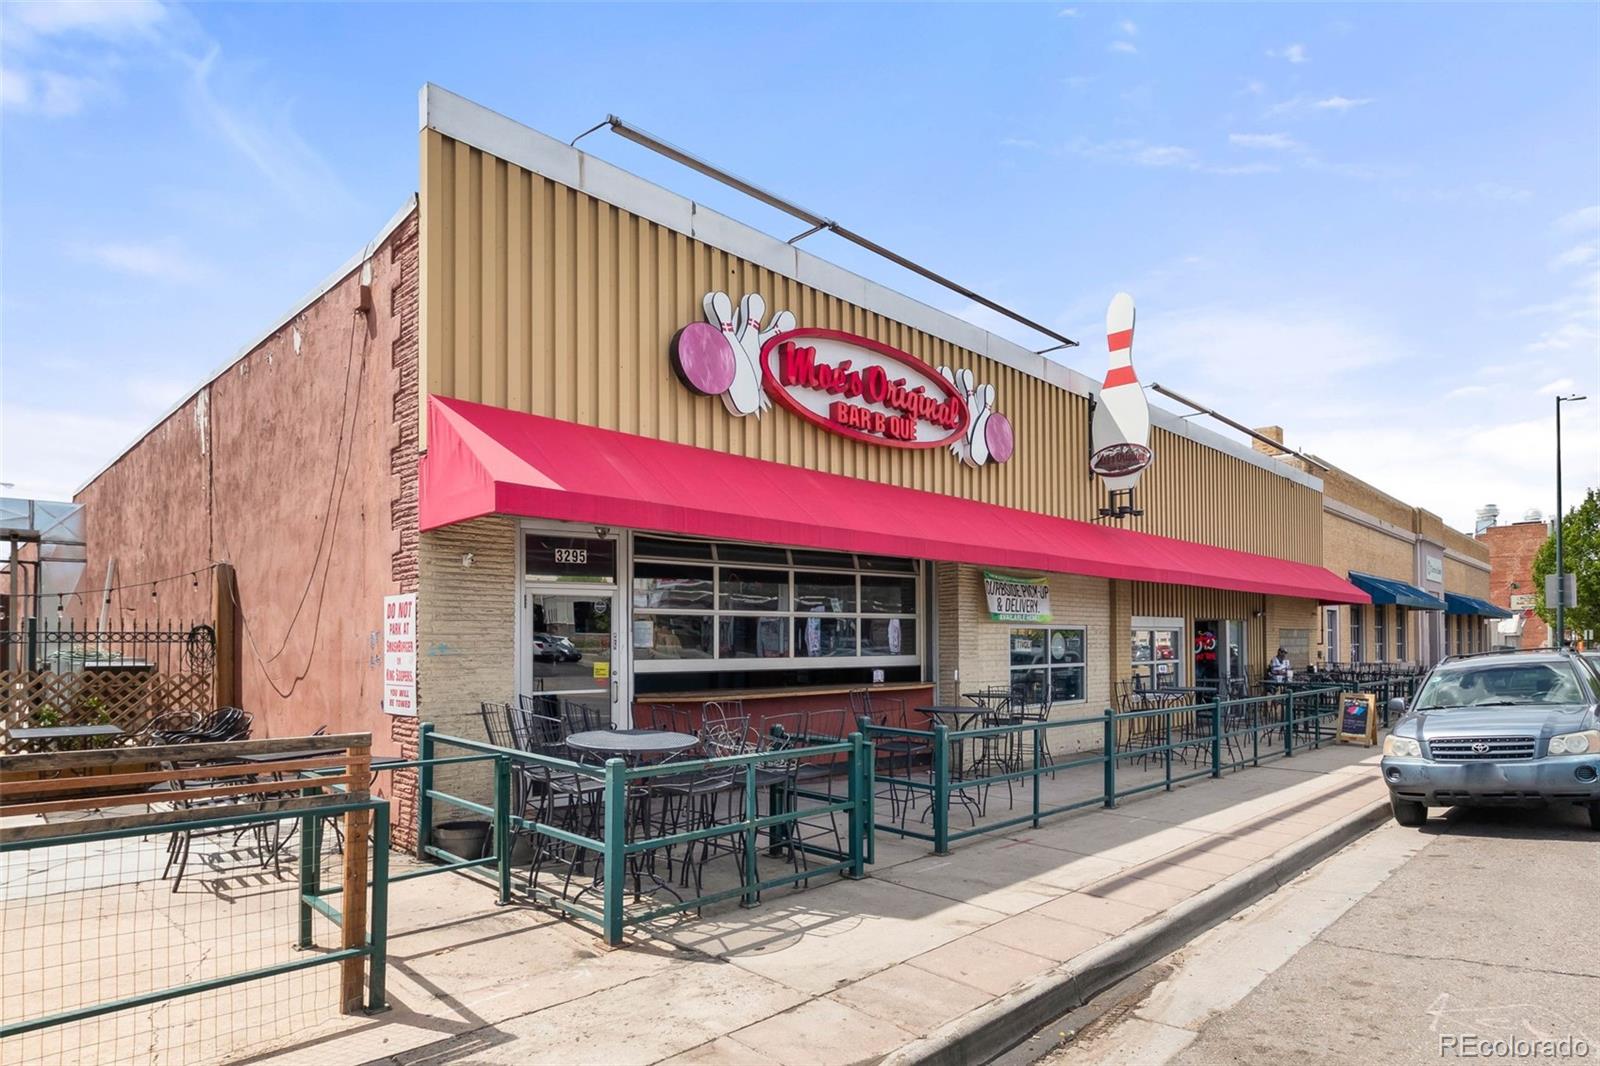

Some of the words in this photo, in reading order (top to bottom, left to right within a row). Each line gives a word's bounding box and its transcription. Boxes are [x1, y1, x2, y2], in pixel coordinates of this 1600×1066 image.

[779, 341, 863, 398] Moe's
[863, 365, 960, 430] Original
[831, 401, 872, 430] BAR
[870, 411, 886, 433] B
[884, 414, 917, 440] QUE
[556, 550, 586, 563] 3295
[386, 603, 396, 619] DO
[398, 601, 413, 618] NOT
[996, 597, 1003, 612] &
[389, 623, 401, 636] PARK
[403, 622, 410, 635] AT
[390, 689, 398, 697] YOU
[399, 689, 409, 698] WILL
